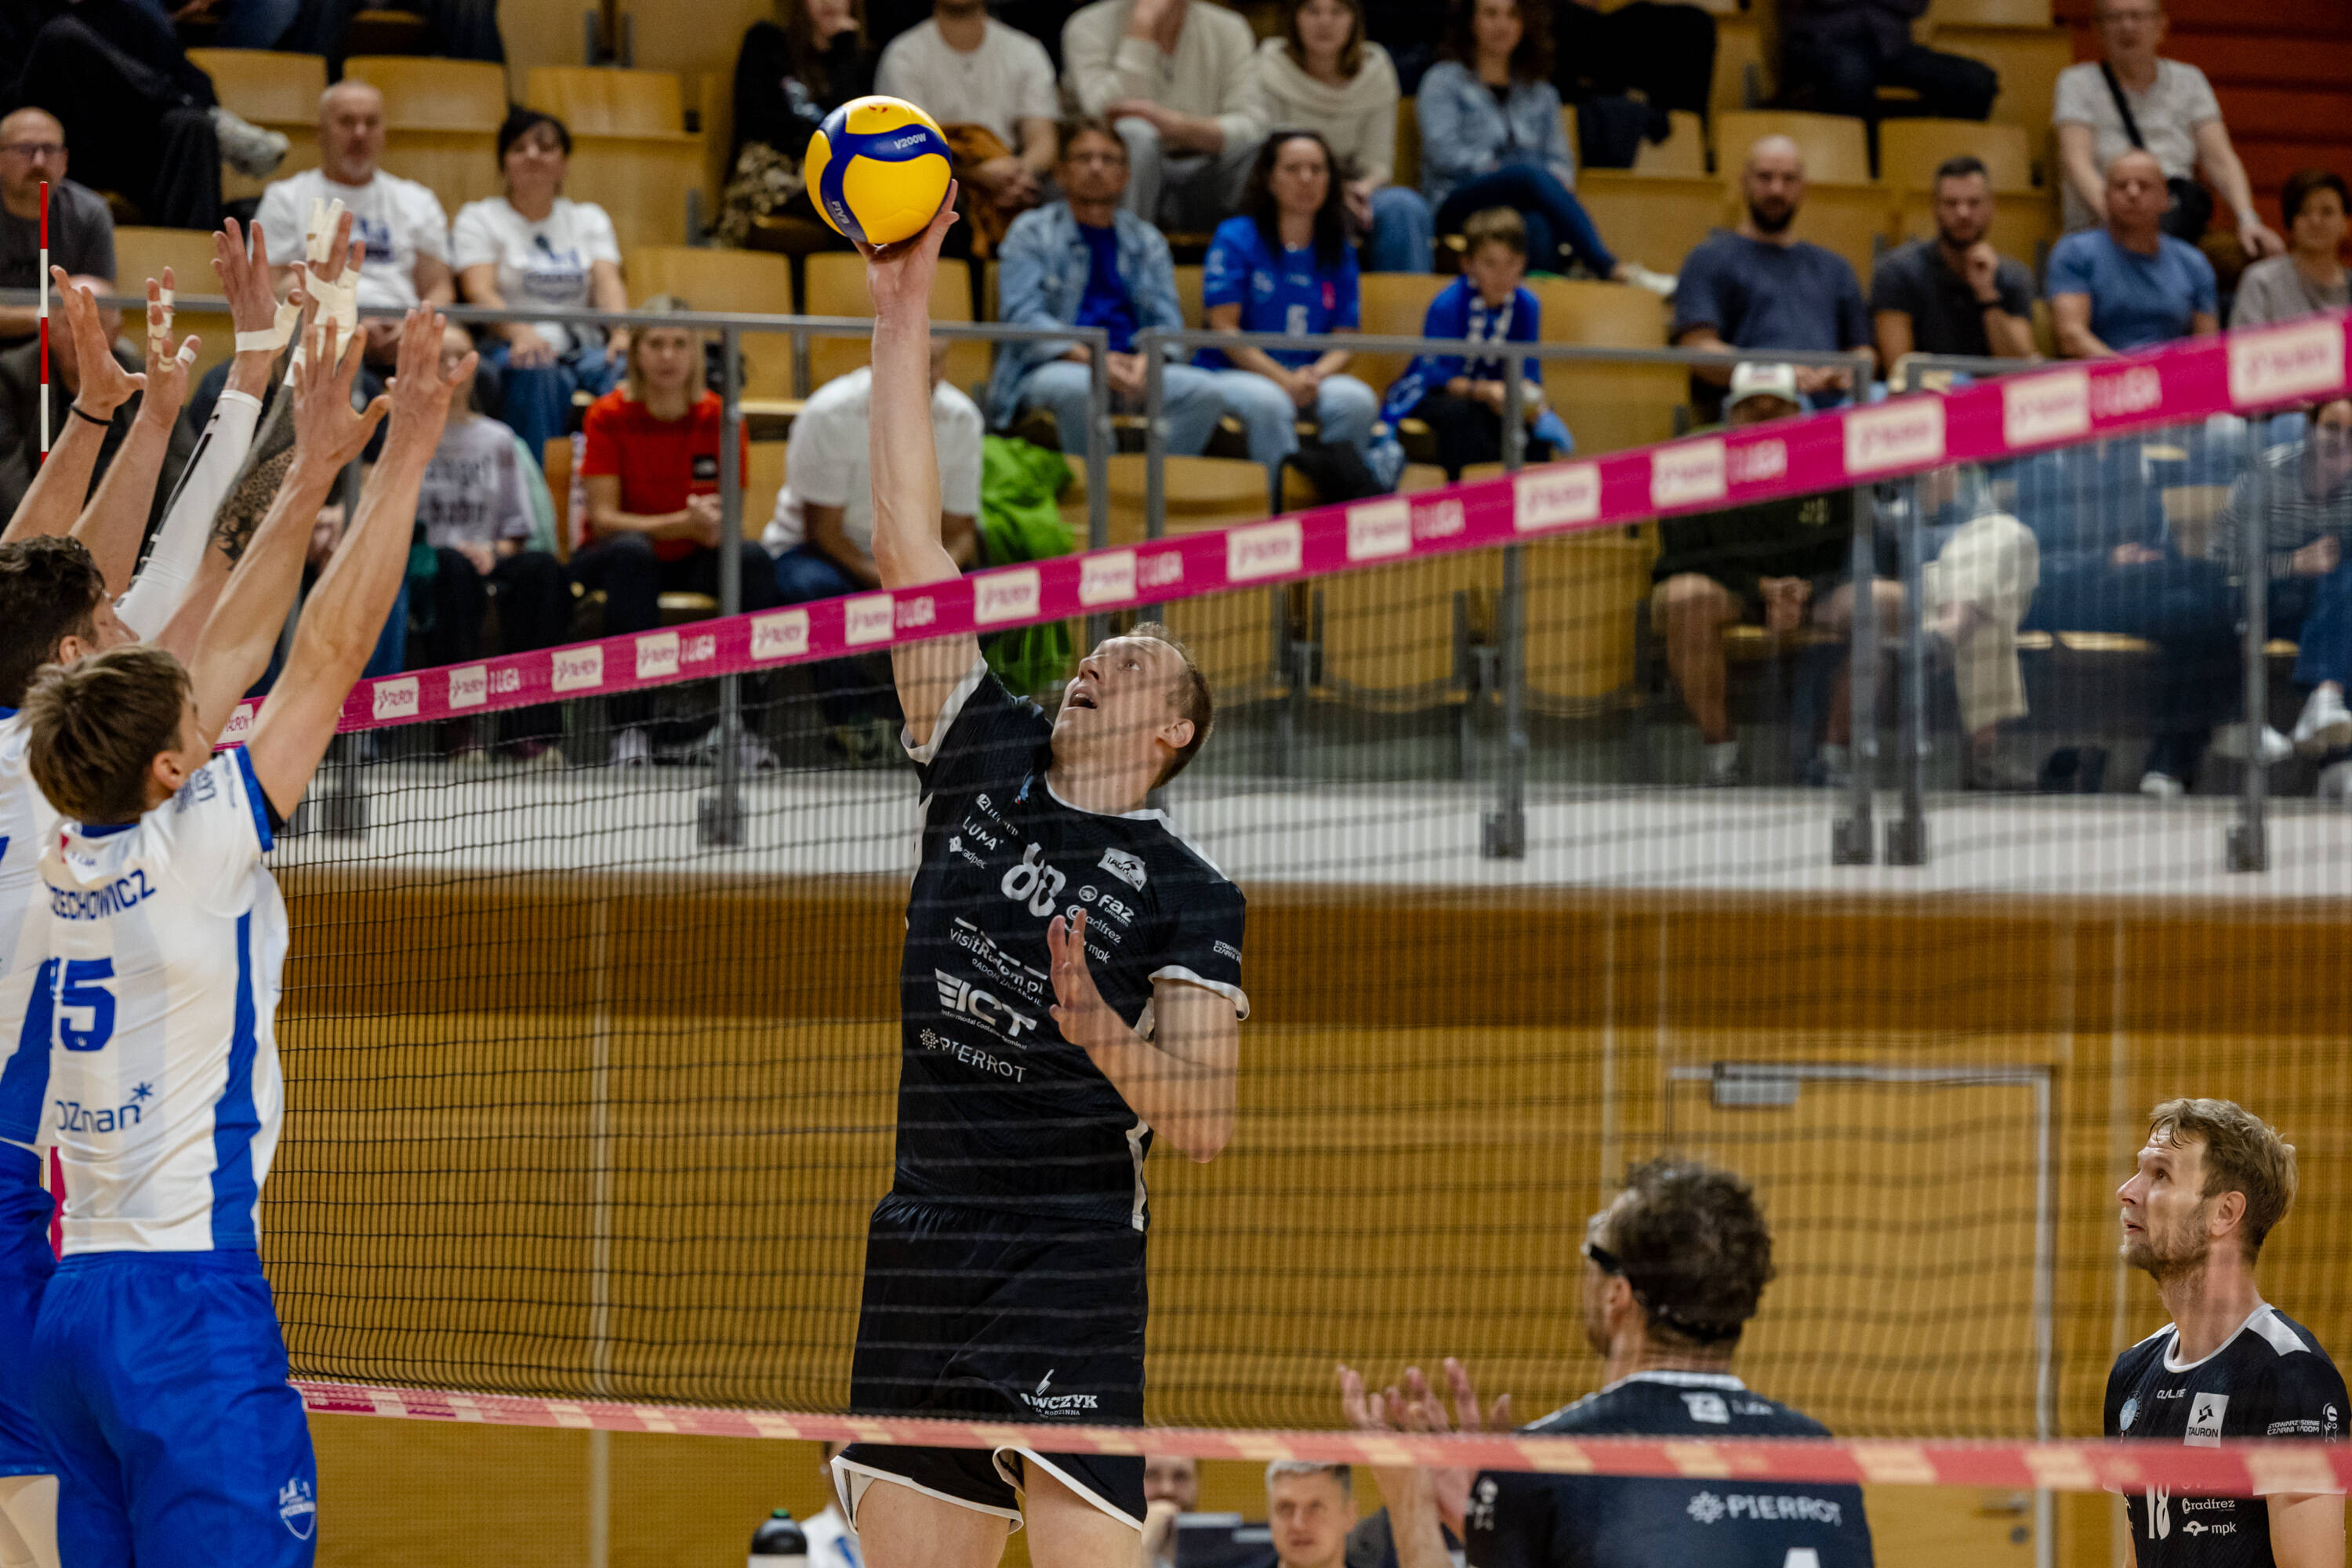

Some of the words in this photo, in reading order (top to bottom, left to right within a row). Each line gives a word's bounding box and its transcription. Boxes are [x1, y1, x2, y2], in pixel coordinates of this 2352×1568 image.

[894, 132, 926, 149] V200W
[831, 200, 850, 224] FIVB
[1085, 915, 1122, 944] adfrez
[1088, 944, 1111, 964] mpk
[2187, 1426, 2219, 1439] TAURON
[2211, 1521, 2237, 1537] mpk
